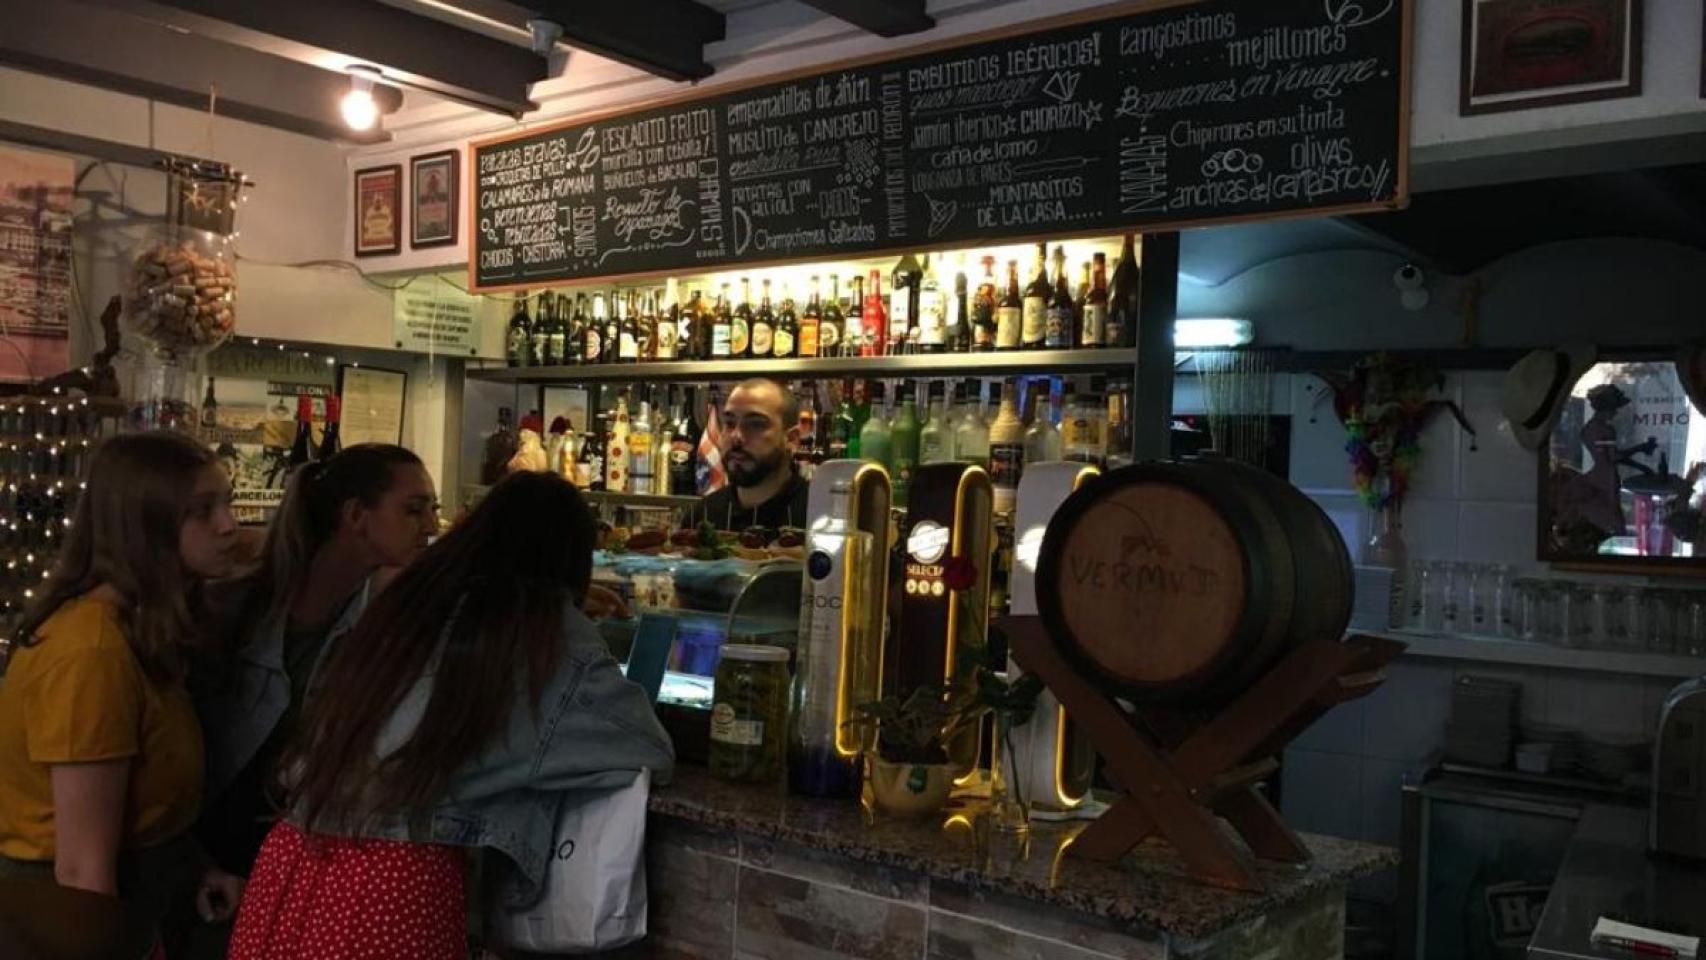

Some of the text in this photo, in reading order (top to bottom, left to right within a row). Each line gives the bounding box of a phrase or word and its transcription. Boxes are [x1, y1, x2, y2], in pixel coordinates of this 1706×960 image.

[1226, 24, 1347, 70] mejillones
[909, 54, 1000, 92] EMBUTIDOS
[1241, 73, 1267, 98] en
[815, 77, 832, 109] de
[602, 117, 666, 153] PESCADITO
[803, 107, 879, 144] CANGREJO
[977, 207, 998, 228] DE
[1001, 204, 1023, 226] LA
